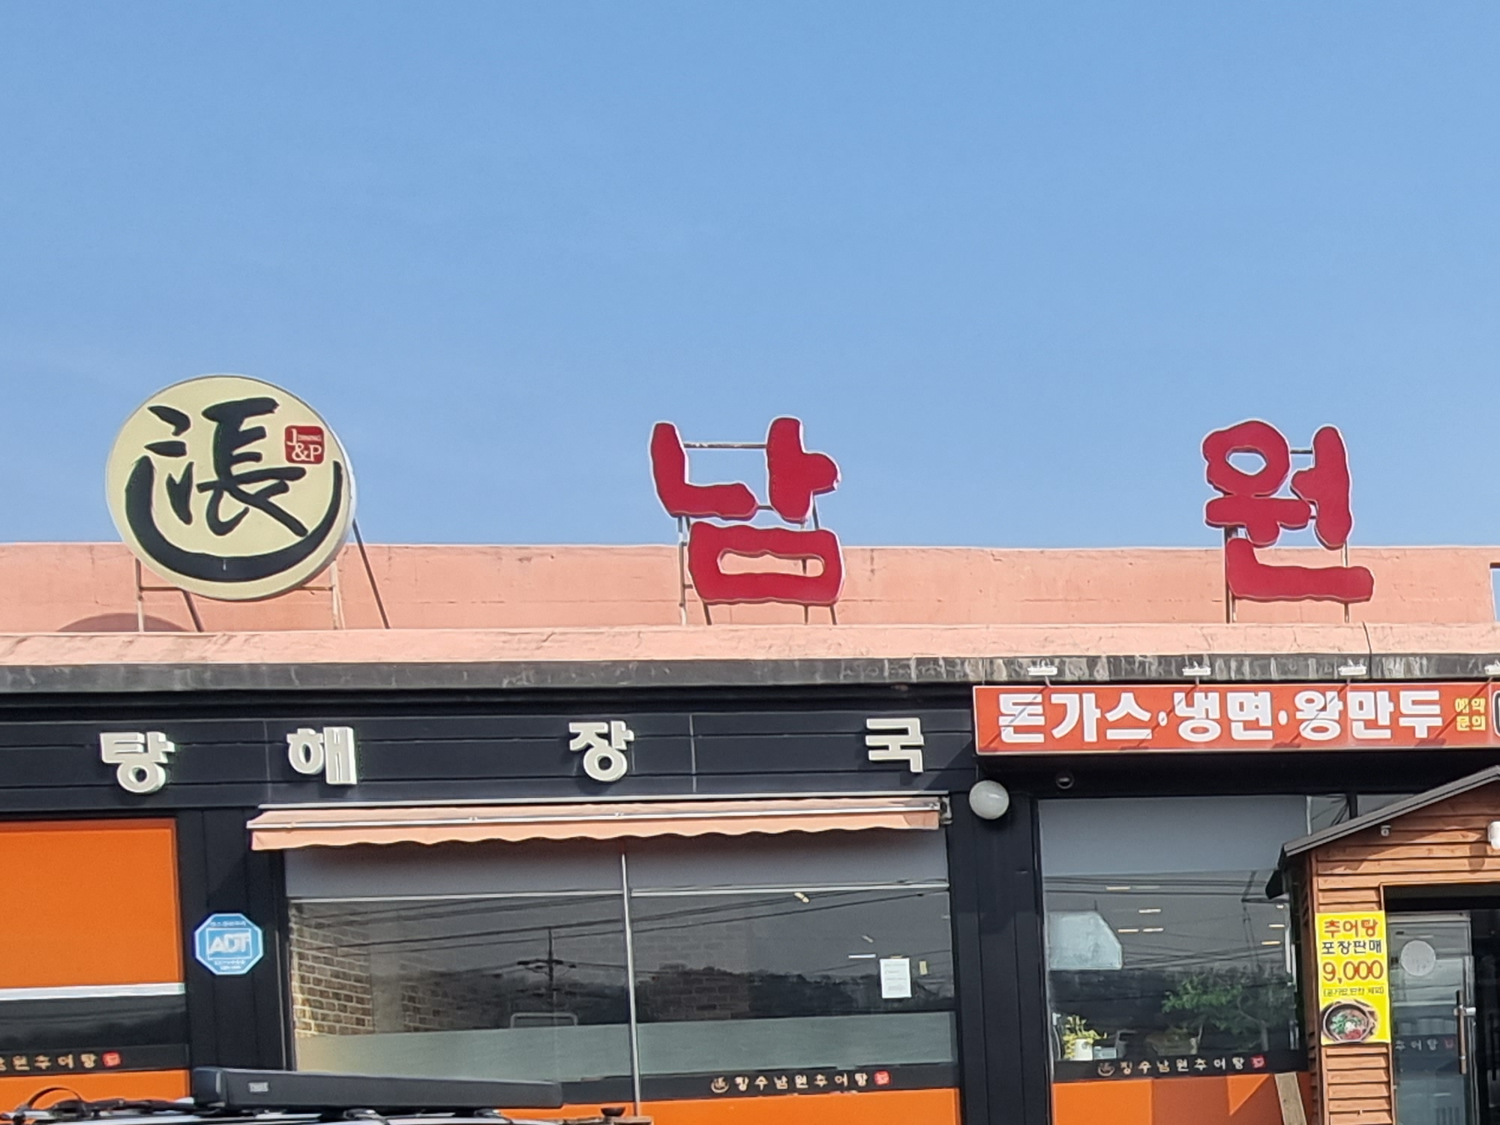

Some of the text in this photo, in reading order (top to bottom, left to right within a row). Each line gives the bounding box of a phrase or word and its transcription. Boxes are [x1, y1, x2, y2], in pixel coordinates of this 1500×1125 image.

[1454, 697, 1486, 713] 예약
[1456, 716, 1486, 731] 문의
[1324, 919, 1378, 938] 추어탕
[1322, 940, 1382, 955] 포장판매
[1323, 960, 1384, 984] 9,000
